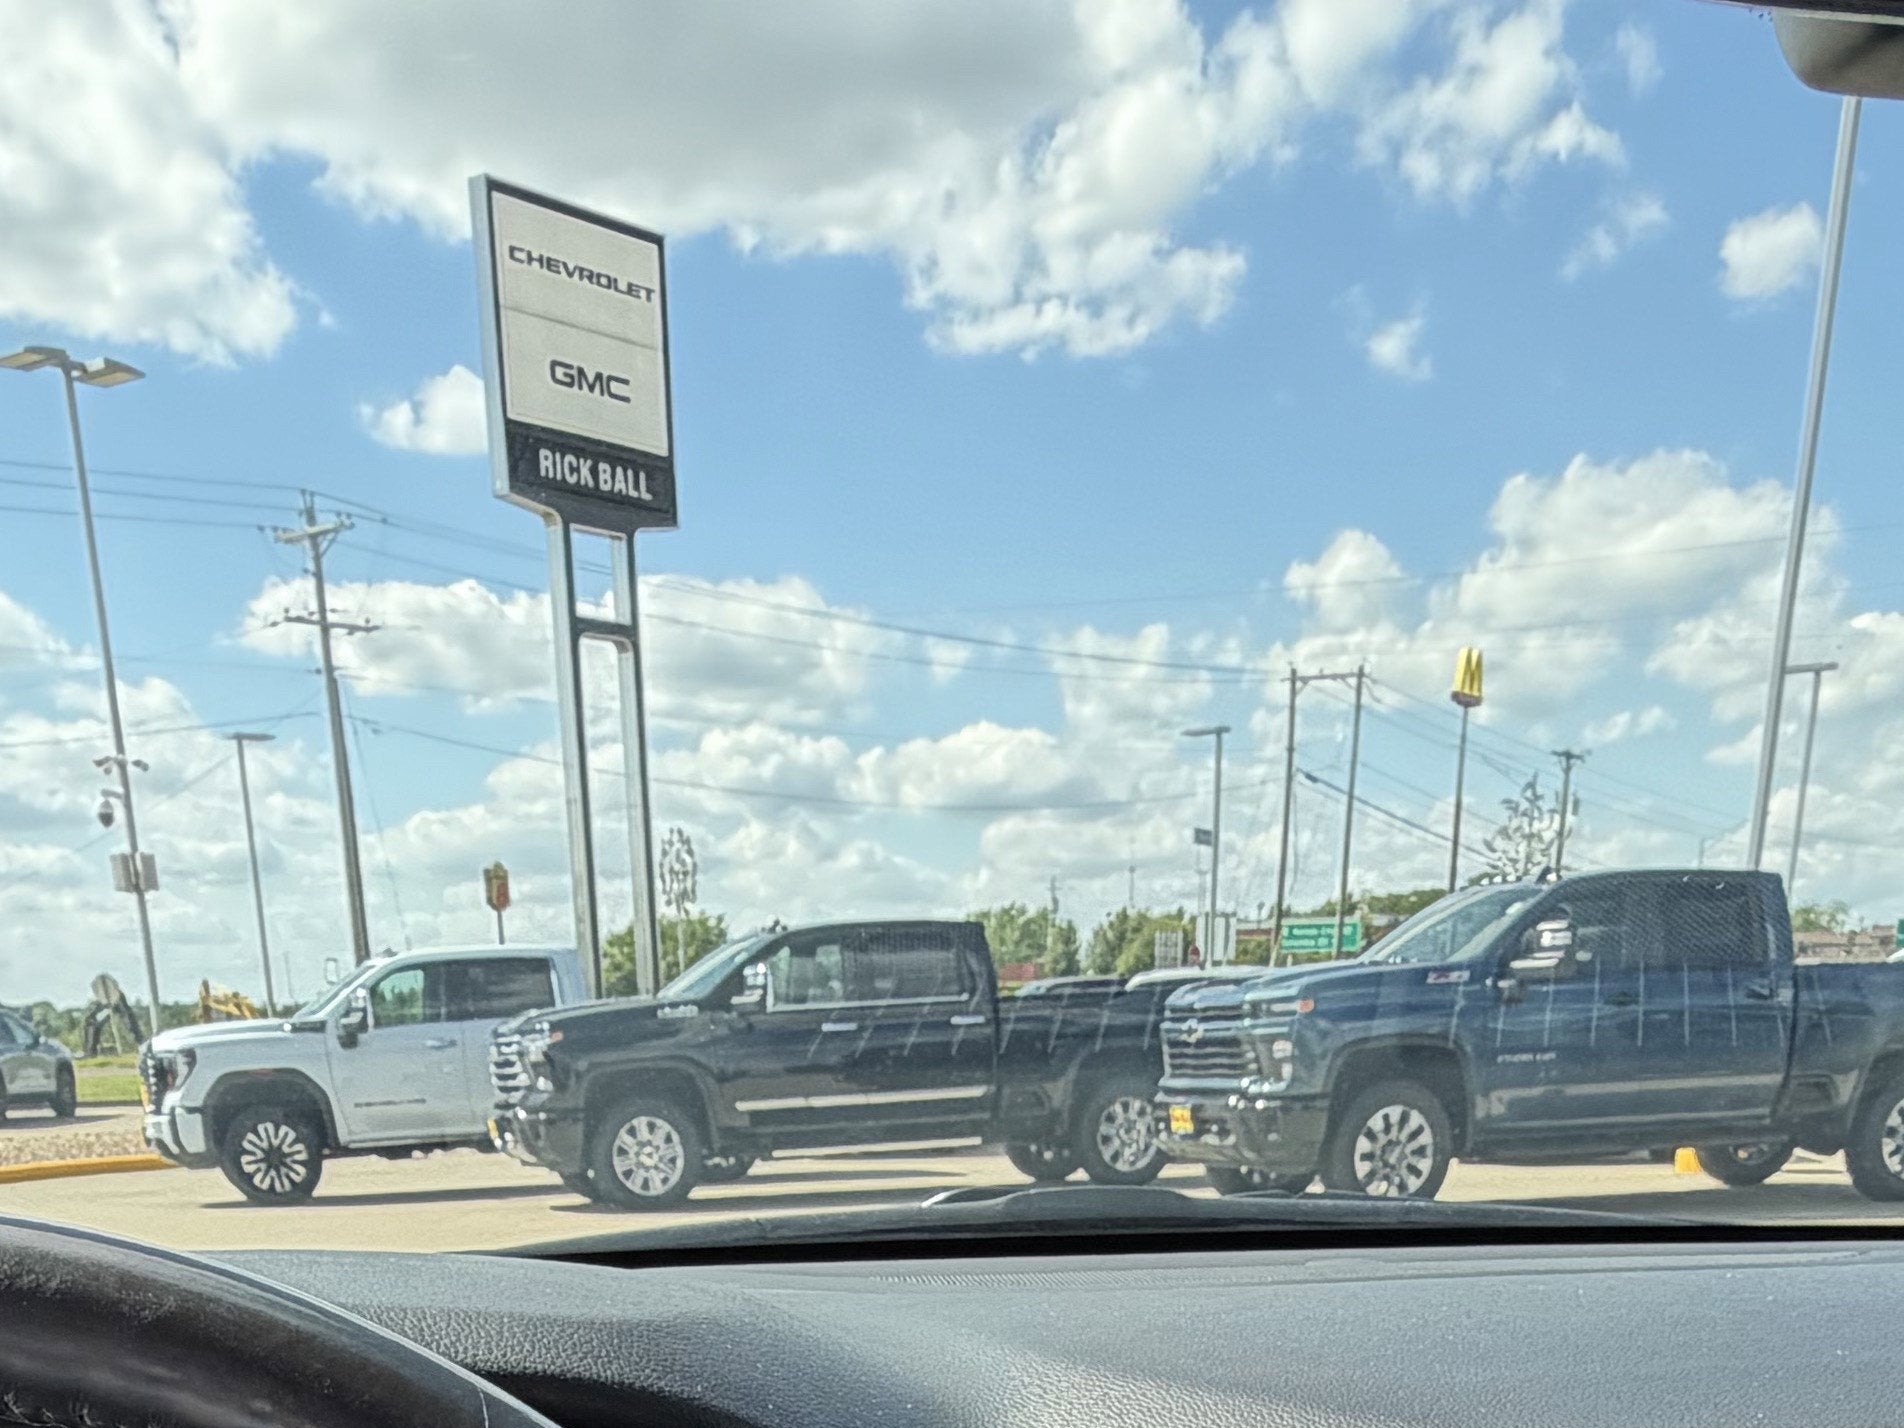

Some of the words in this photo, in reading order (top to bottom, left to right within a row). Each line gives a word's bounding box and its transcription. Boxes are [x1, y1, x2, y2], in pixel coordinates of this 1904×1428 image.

[507, 244, 656, 303] CHEVROLET
[549, 358, 632, 404] GMC
[538, 448, 594, 491] RICK
[598, 465, 654, 502] BALL
